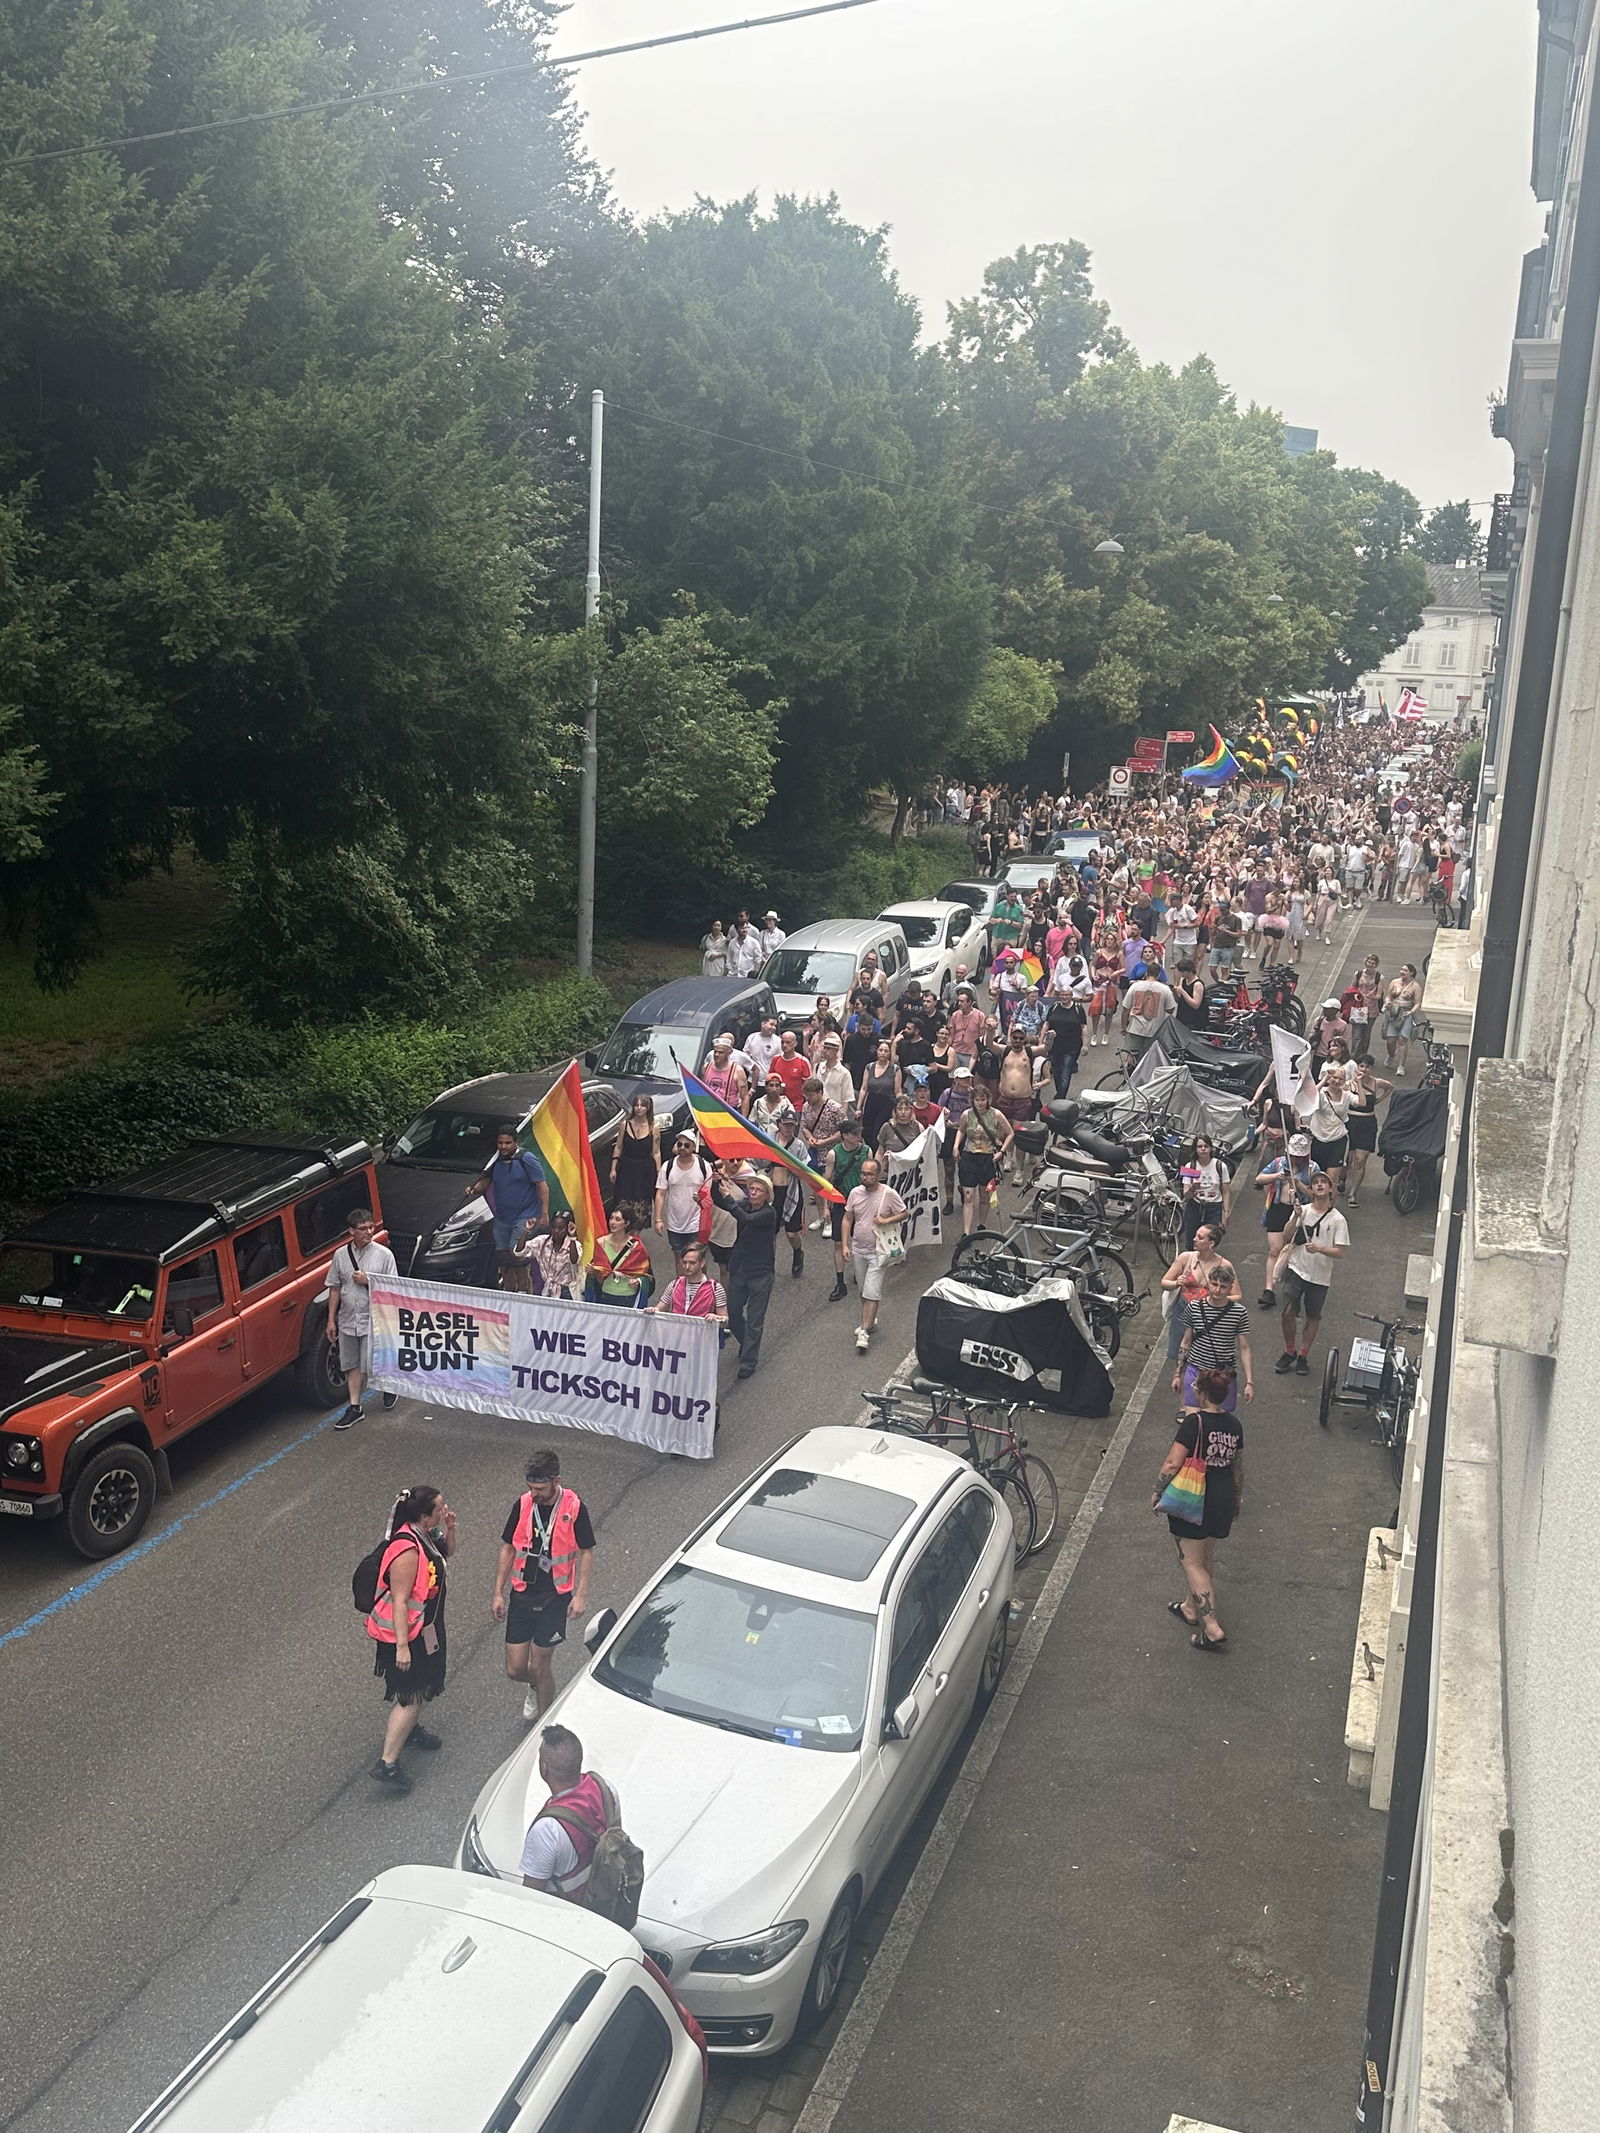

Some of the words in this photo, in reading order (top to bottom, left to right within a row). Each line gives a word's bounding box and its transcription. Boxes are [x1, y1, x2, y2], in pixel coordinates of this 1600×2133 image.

[399, 1308, 479, 1331] BASEL
[400, 1331, 479, 1354] TICKT
[530, 1328, 587, 1357] WIE
[602, 1338, 686, 1374] BUNT
[398, 1349, 479, 1372] BUNT
[511, 1365, 640, 1409] TICKSCH
[651, 1391, 711, 1423] DU?
[1367, 2062, 1380, 2091] DOUBT
